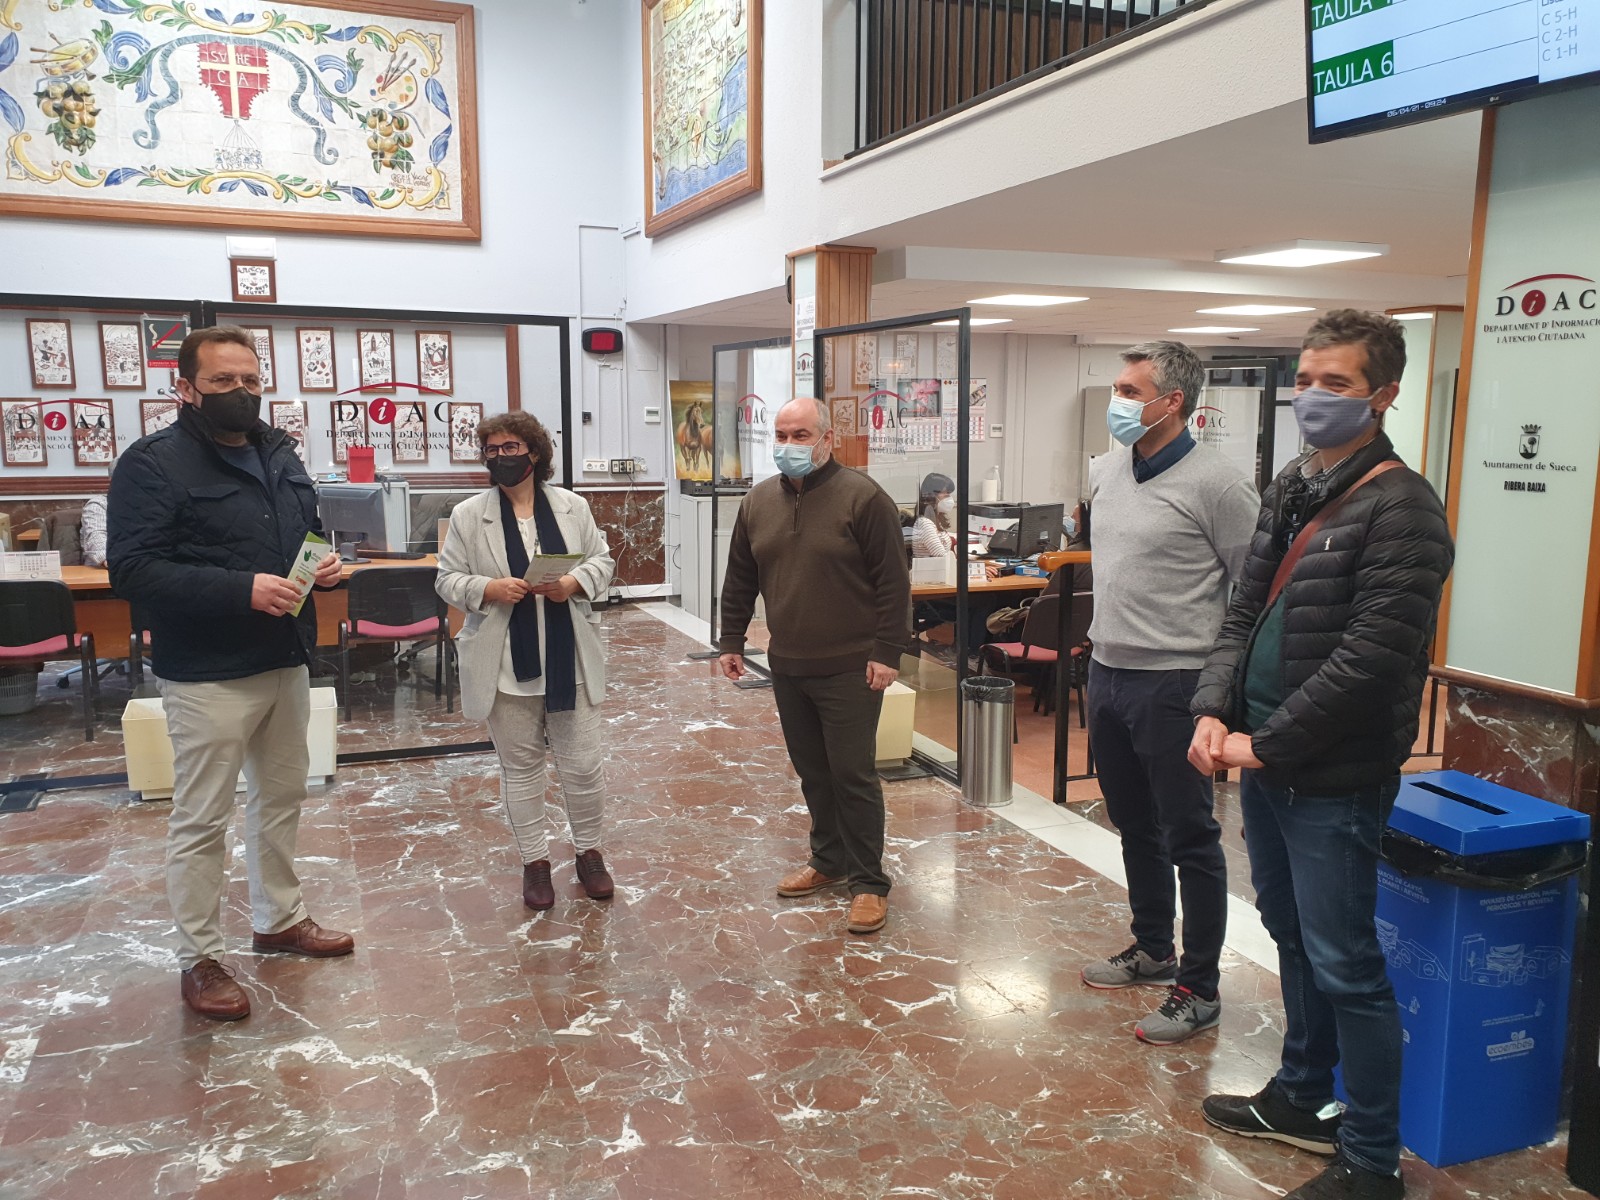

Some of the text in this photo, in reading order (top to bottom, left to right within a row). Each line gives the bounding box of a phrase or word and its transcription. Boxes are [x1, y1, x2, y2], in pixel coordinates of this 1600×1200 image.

[1312, 0, 1373, 27] TAULA
[1541, 6, 1577, 26] C 5-H
[1541, 24, 1577, 44] C 2-H
[1542, 42, 1578, 62] C 1-H
[1313, 52, 1393, 93] TAULA 6
[1483, 322, 1540, 333] DEPARTAMENT
[1537, 332, 1586, 342] CIUTADANA
[1535, 461, 1546, 471] de
[1549, 462, 1577, 472] Sueca
[1503, 480, 1546, 493] RIBERA BAIXA
[1488, 1039, 1533, 1055] ecoembes
